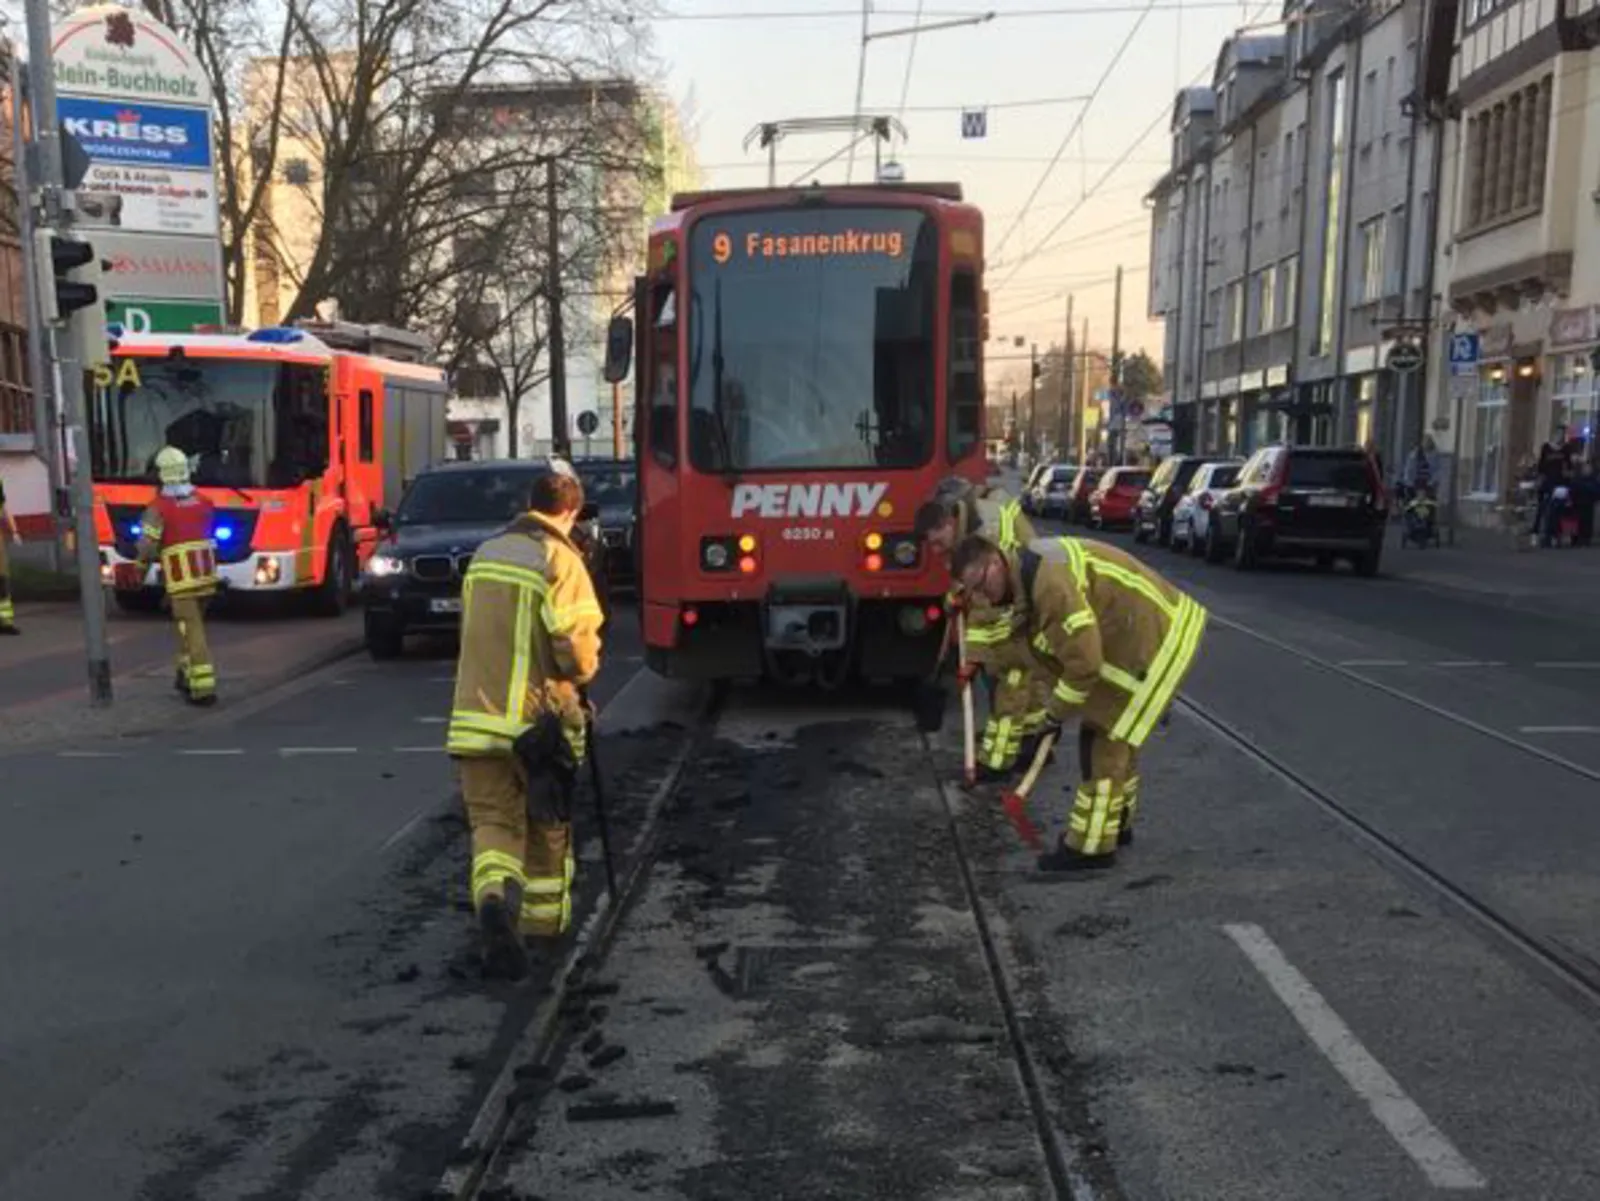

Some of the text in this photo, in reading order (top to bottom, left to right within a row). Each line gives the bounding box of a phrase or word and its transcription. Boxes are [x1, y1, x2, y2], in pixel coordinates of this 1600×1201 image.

[52, 60, 198, 97] lein-Buchholz
[63, 117, 188, 144] KRESS
[712, 228, 903, 263] 9 Fasanenkrug
